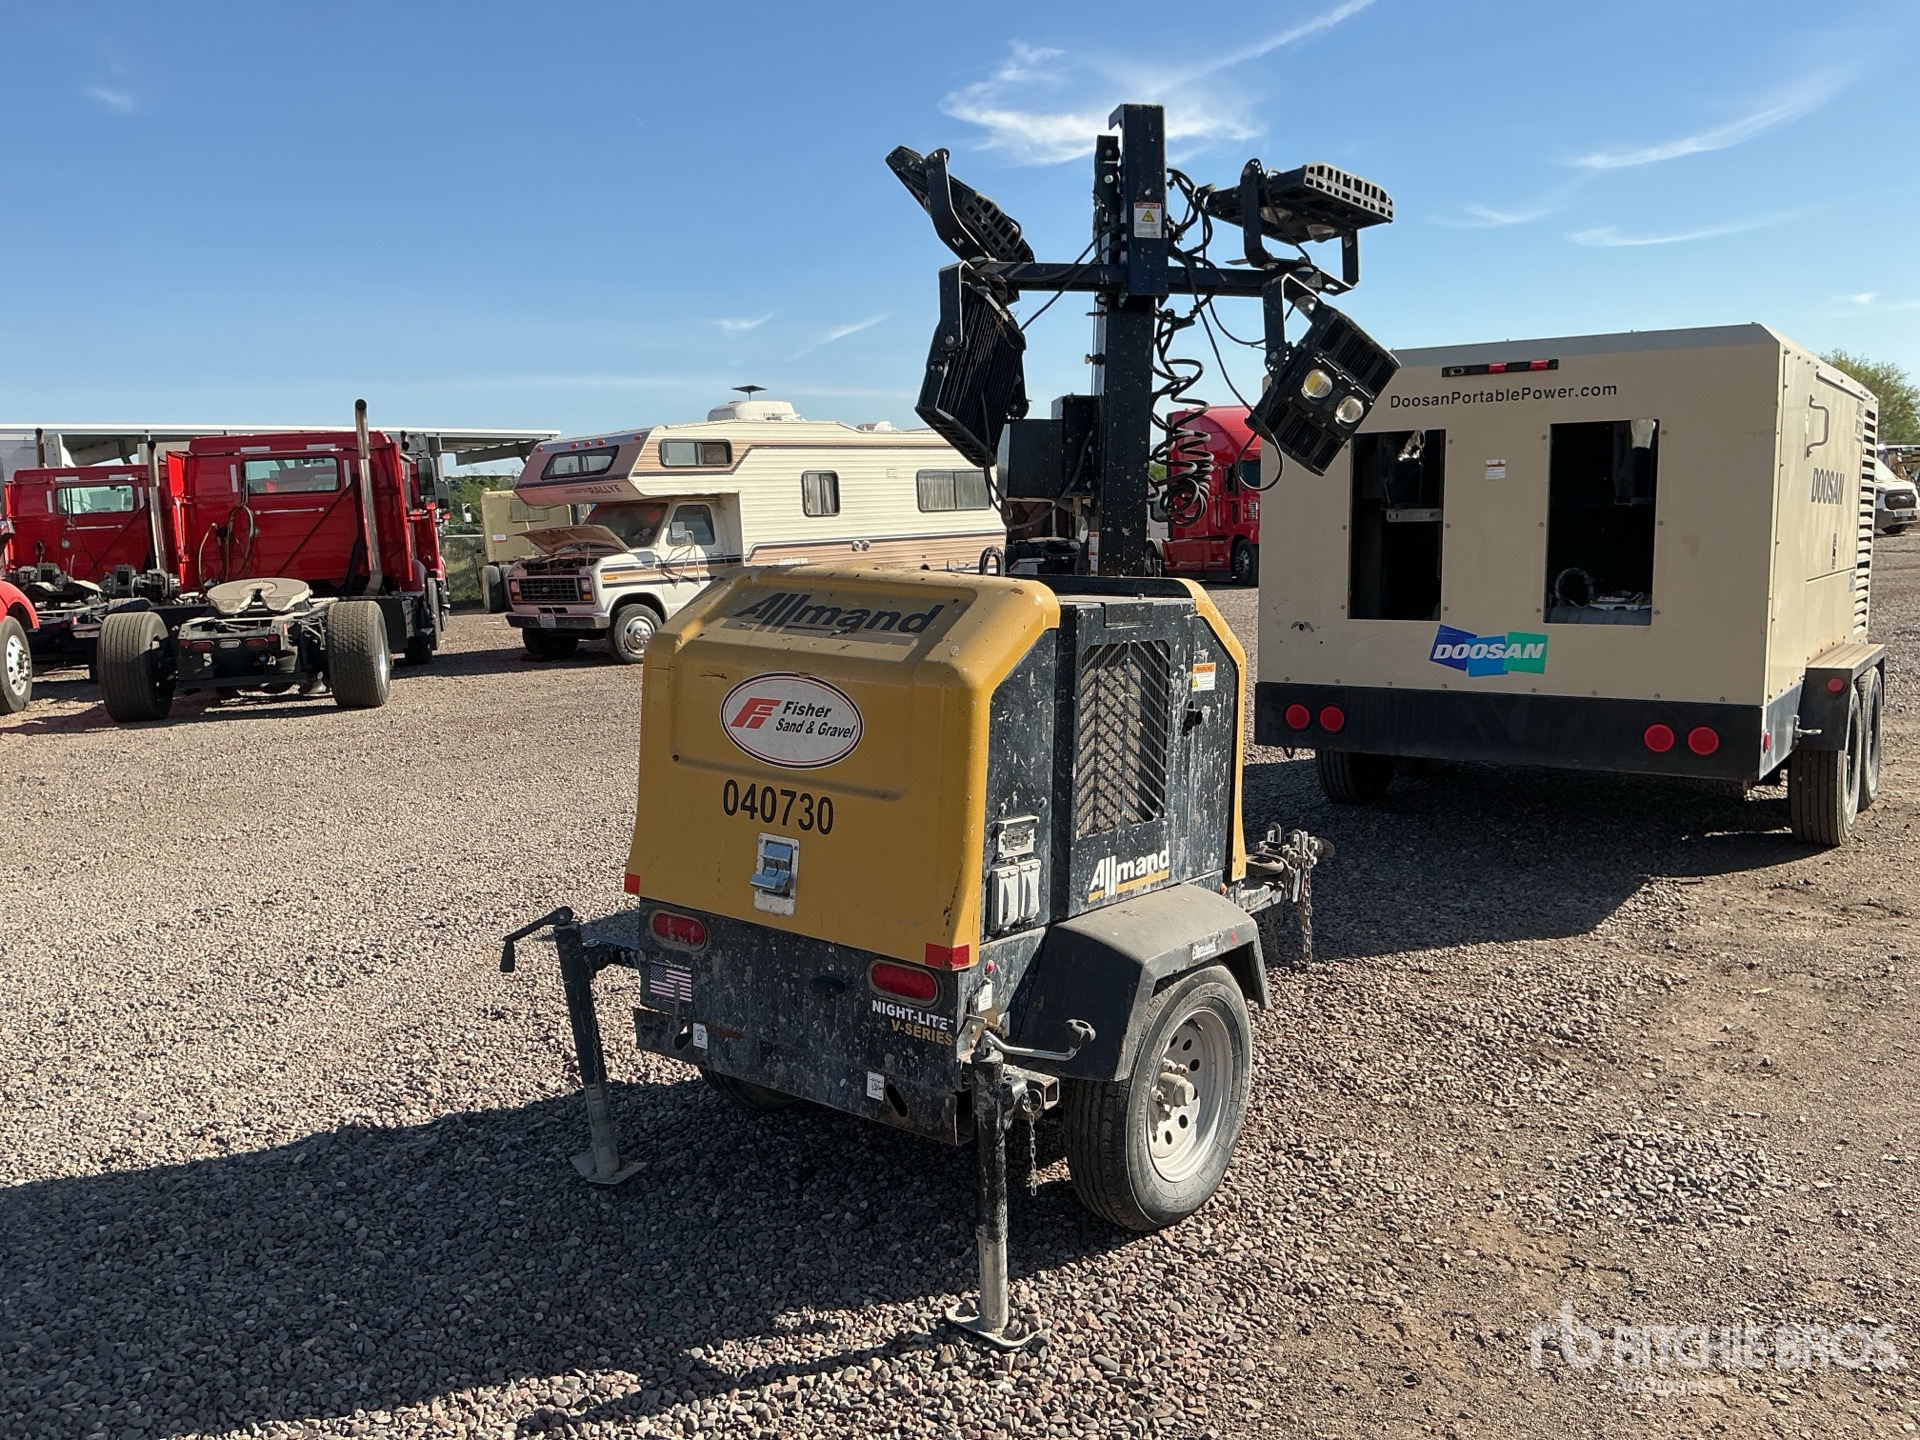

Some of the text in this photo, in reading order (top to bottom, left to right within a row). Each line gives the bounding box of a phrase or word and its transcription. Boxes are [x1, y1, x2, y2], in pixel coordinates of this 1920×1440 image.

[1390, 385, 1618, 408] DoosanPortablePower.com
[587, 484, 622, 495] RALLYE
[1811, 467, 1845, 505] DOOSAN
[733, 592, 945, 632] Allmand
[1433, 643, 1544, 659] DOOSAN
[782, 701, 832, 718] Fisher
[775, 718, 856, 739] Sand & Gravel
[723, 779, 834, 835] 040730
[1089, 841, 1170, 897] Allmand
[890, 1019, 954, 1047] V-SERIES
